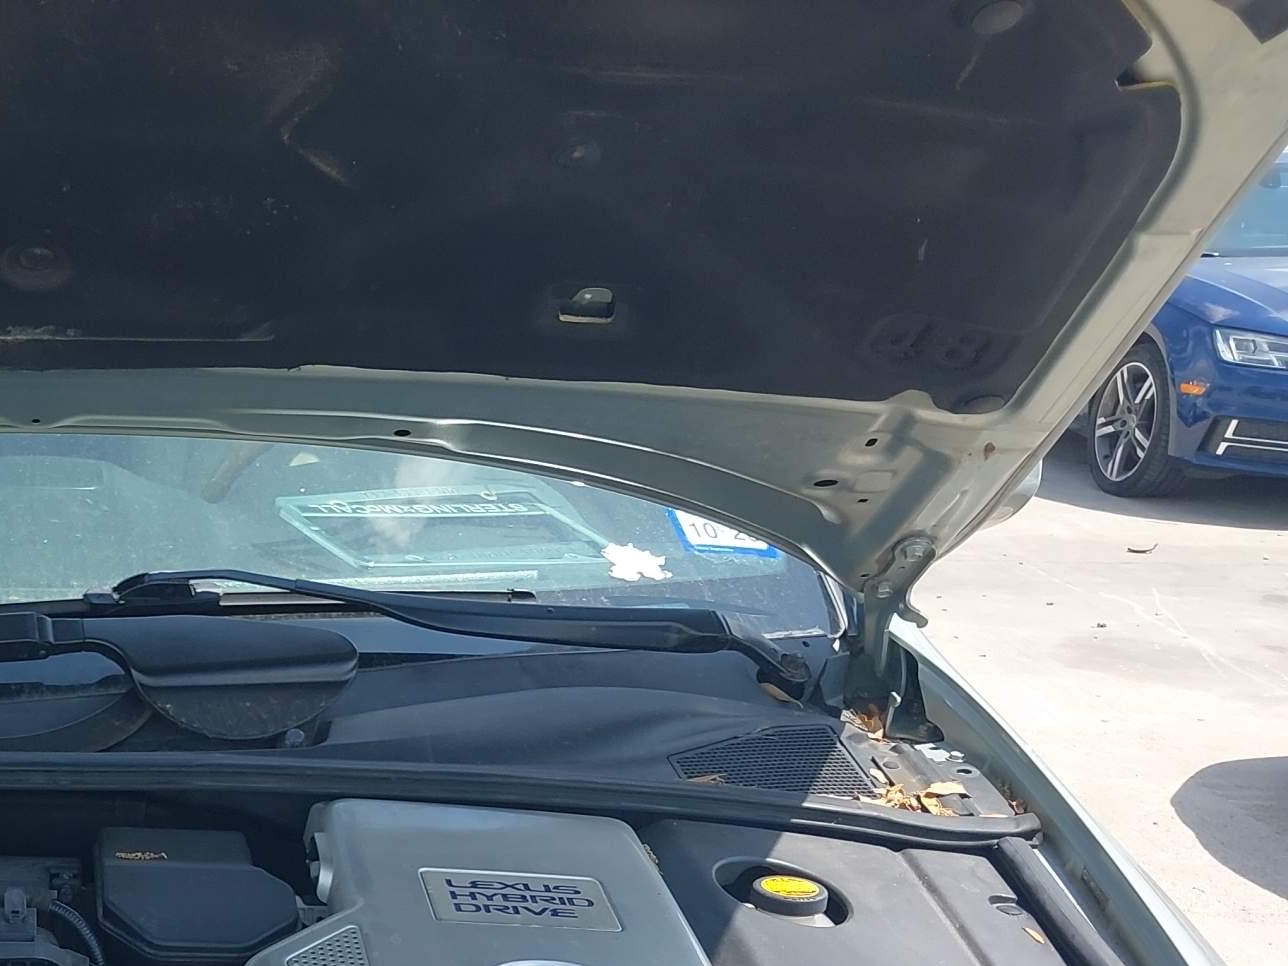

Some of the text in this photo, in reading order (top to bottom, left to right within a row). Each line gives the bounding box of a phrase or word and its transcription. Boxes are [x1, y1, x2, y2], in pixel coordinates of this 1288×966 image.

[445, 878, 581, 895] LEXUS
[449, 890, 594, 908] HYBRID
[453, 902, 579, 919] DRIVE
